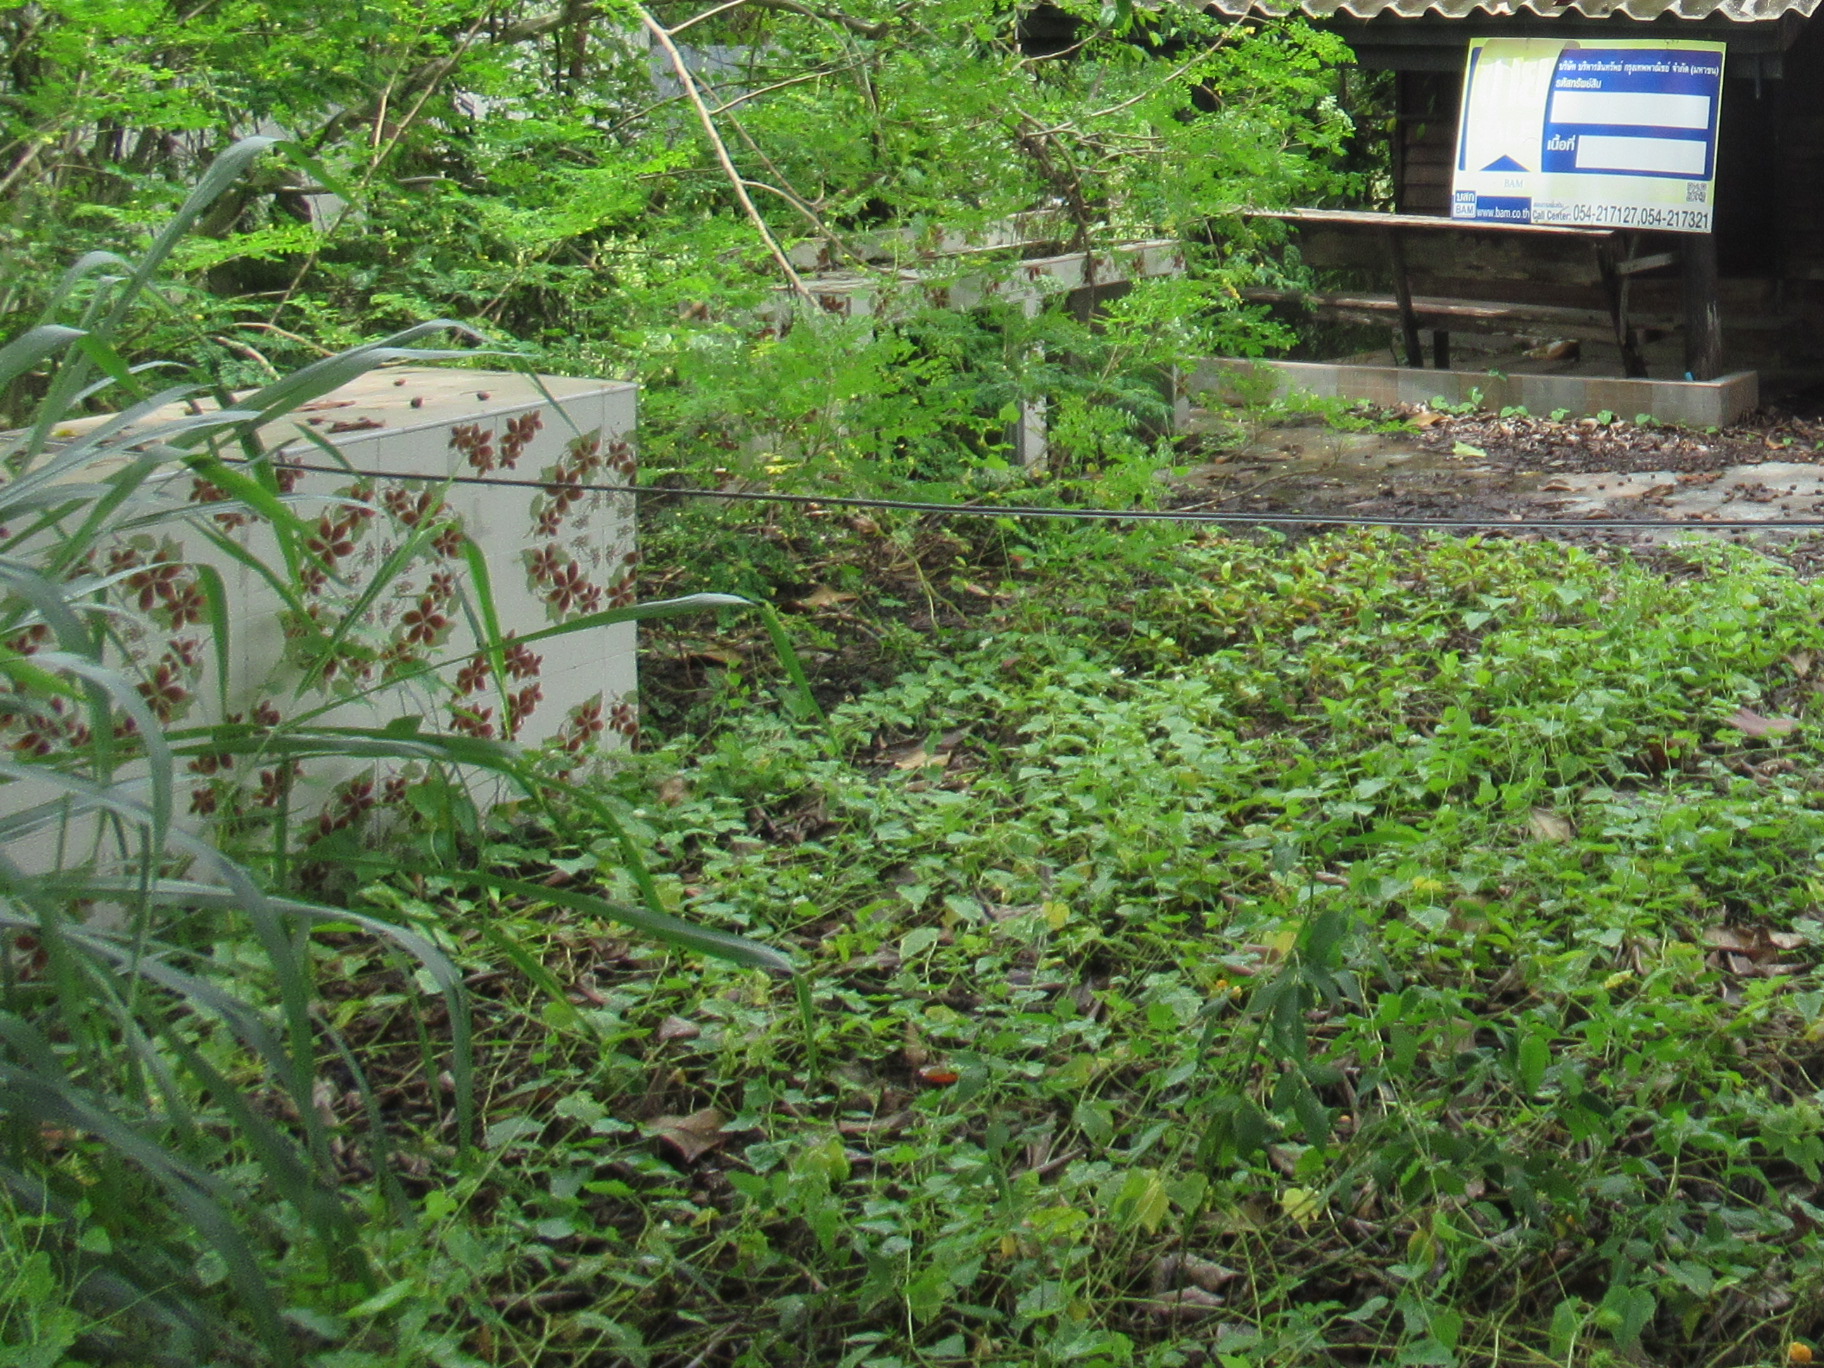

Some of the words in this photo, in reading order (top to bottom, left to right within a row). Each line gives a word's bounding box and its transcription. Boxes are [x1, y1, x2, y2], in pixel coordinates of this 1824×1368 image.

[1547, 133, 1576, 151] เนื้อที่
[1504, 179, 1523, 188] BAM
[1456, 204, 1474, 214] BAM
[1477, 206, 1530, 219] www.bam.co.th
